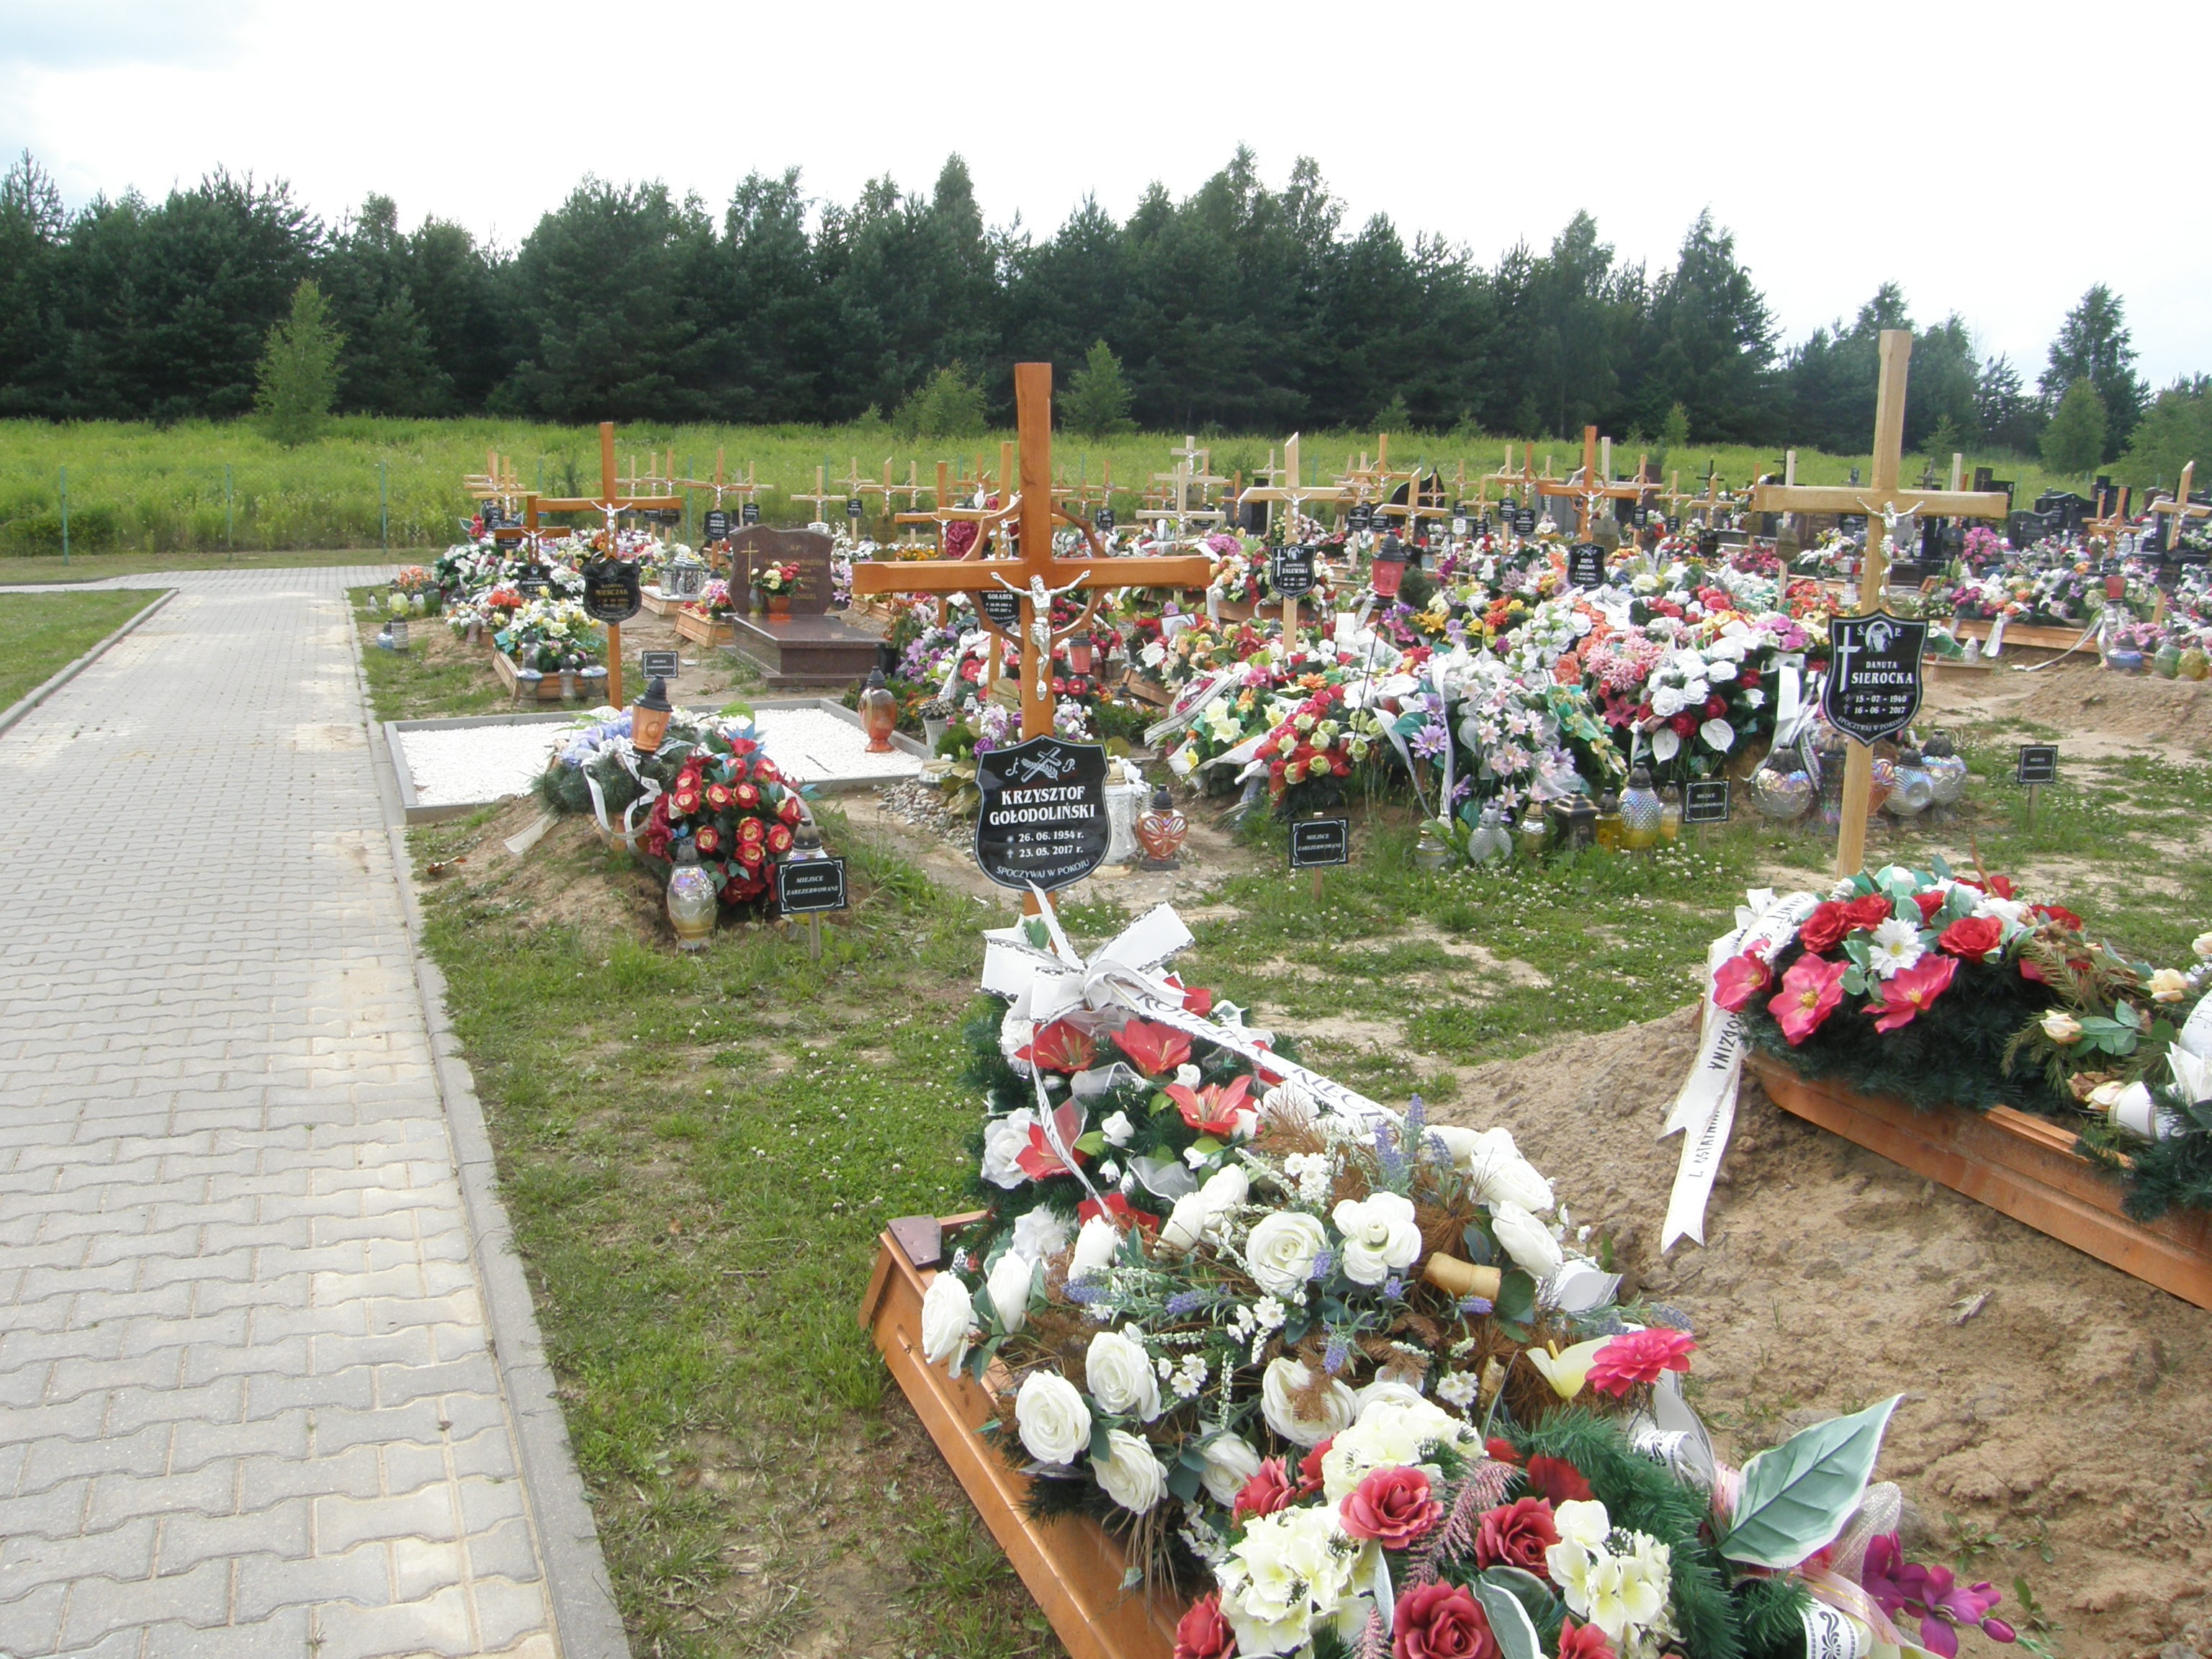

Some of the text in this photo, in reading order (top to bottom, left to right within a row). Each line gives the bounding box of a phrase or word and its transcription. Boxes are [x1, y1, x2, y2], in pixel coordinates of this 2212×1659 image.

[1851, 672, 1913, 684] SIEROCKA
[1001, 786, 1086, 806] KRZYSZTOF
[989, 802, 1095, 826] GOŁODOLIŃSKI
[1018, 833, 1034, 842] 26.
[1035, 832, 1051, 840] 06.
[1053, 830, 1076, 840] 1954
[1019, 849, 1034, 858] 23.
[1052, 845, 1074, 855] 2017
[996, 858, 1090, 878] SPOCZYWAJ W POKOJU
